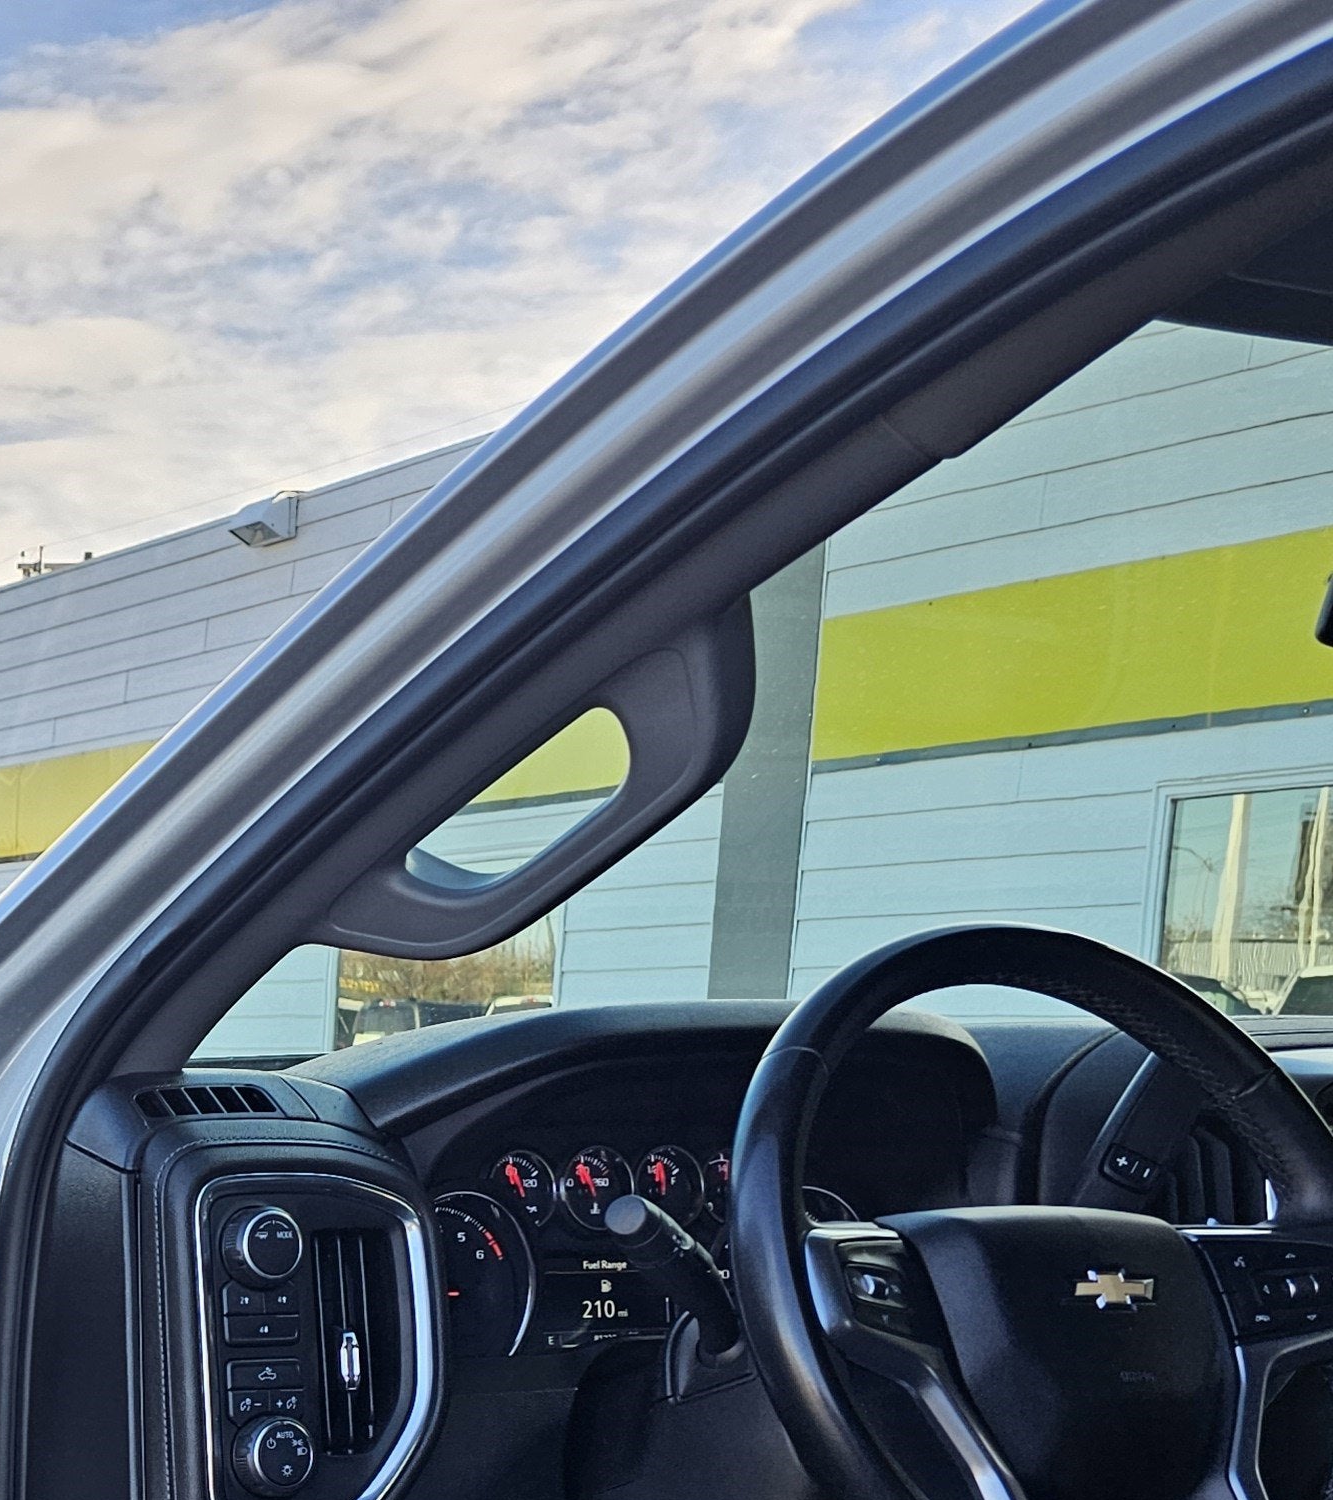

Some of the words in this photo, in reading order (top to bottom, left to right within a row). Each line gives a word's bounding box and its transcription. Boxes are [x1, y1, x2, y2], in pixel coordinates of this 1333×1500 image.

[276, 1230, 293, 1239] MODE
[457, 1231, 466, 1242] 5
[475, 1250, 484, 1260] 6
[583, 1260, 601, 1270] Fuel
[602, 1260, 628, 1271] Range
[582, 1300, 616, 1319] 210
[617, 1309, 629, 1318] mi
[547, 1336, 555, 1346] E
[276, 1431, 294, 1439] AUTO
